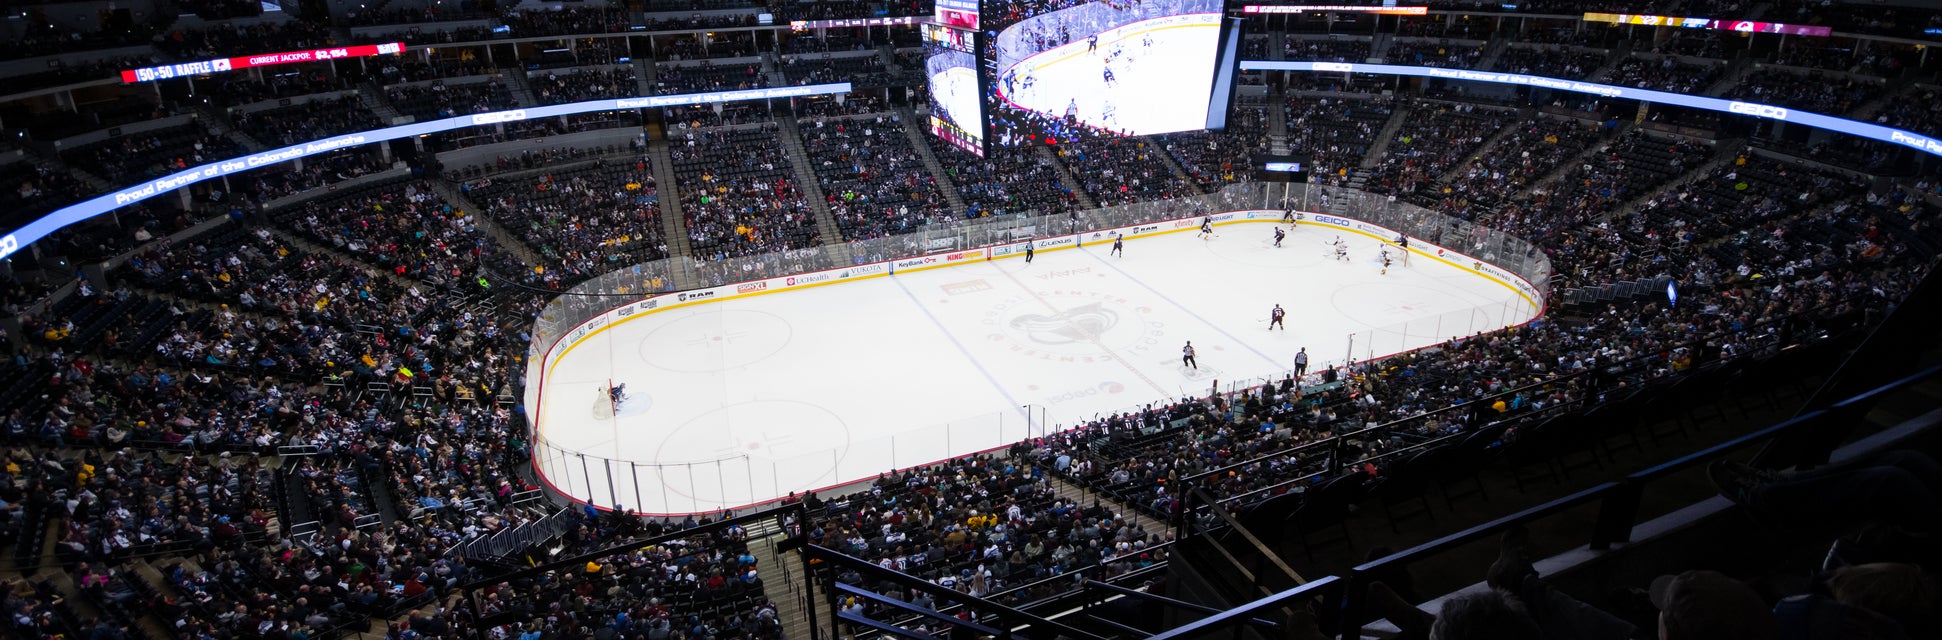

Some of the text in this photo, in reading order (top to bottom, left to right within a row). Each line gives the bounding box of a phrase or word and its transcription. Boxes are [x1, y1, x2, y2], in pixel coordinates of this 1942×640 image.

[250, 56, 279, 65] CURRENT
[280, 52, 311, 62] JACKPOT:
[175, 61, 211, 76] RAFFLE
[1429, 68, 1622, 97] Proud Partner of the Colorado Avalanche
[616, 86, 811, 109] Proud Partner of the Colorado Avalanche
[472, 109, 526, 125] GEICO
[1729, 101, 1787, 120] GEICO
[1891, 131, 1927, 148] Proud
[115, 134, 366, 205] Proud Partner of the Colorado Avalanche
[1174, 218, 1195, 229] xfinity
[1315, 214, 1350, 227] GEICO
[1140, 225, 1158, 233] RAM
[1047, 238, 1072, 246] LEXUS
[851, 264, 882, 275] VUKOTA
[898, 259, 924, 269] KeyBank
[796, 273, 830, 285] UCHealth
[1481, 265, 1512, 282] DRAFTKINGS
[689, 290, 715, 299] RAM
